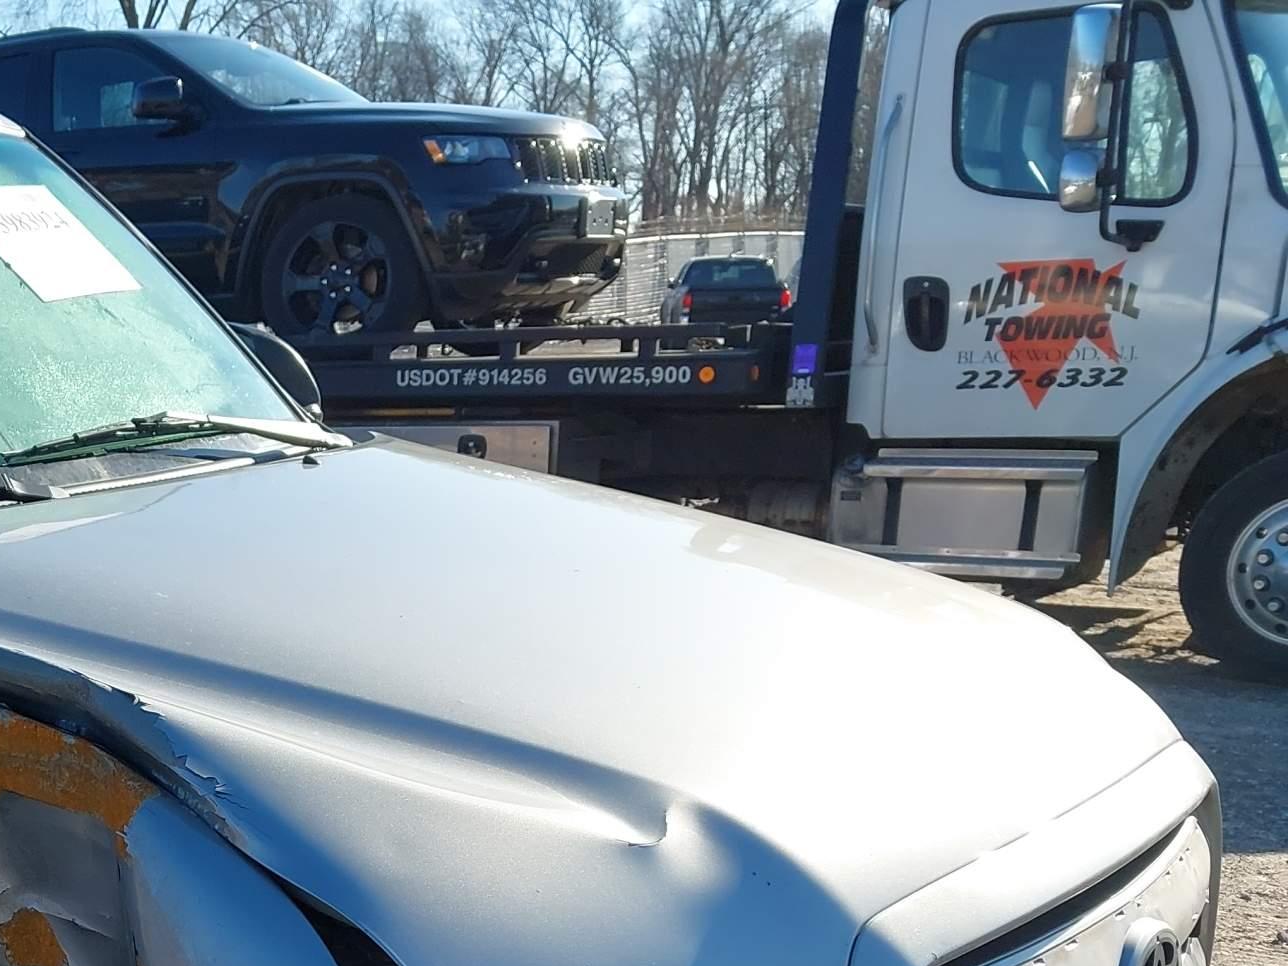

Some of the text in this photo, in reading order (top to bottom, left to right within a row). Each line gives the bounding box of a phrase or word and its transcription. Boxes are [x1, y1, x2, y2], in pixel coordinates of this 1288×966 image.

[963, 264, 1140, 325] NATIONAL
[984, 313, 1111, 342] TOWING
[396, 366, 691, 386] USDOT#914256 GVW25,900
[955, 366, 1129, 391] 227-6332
